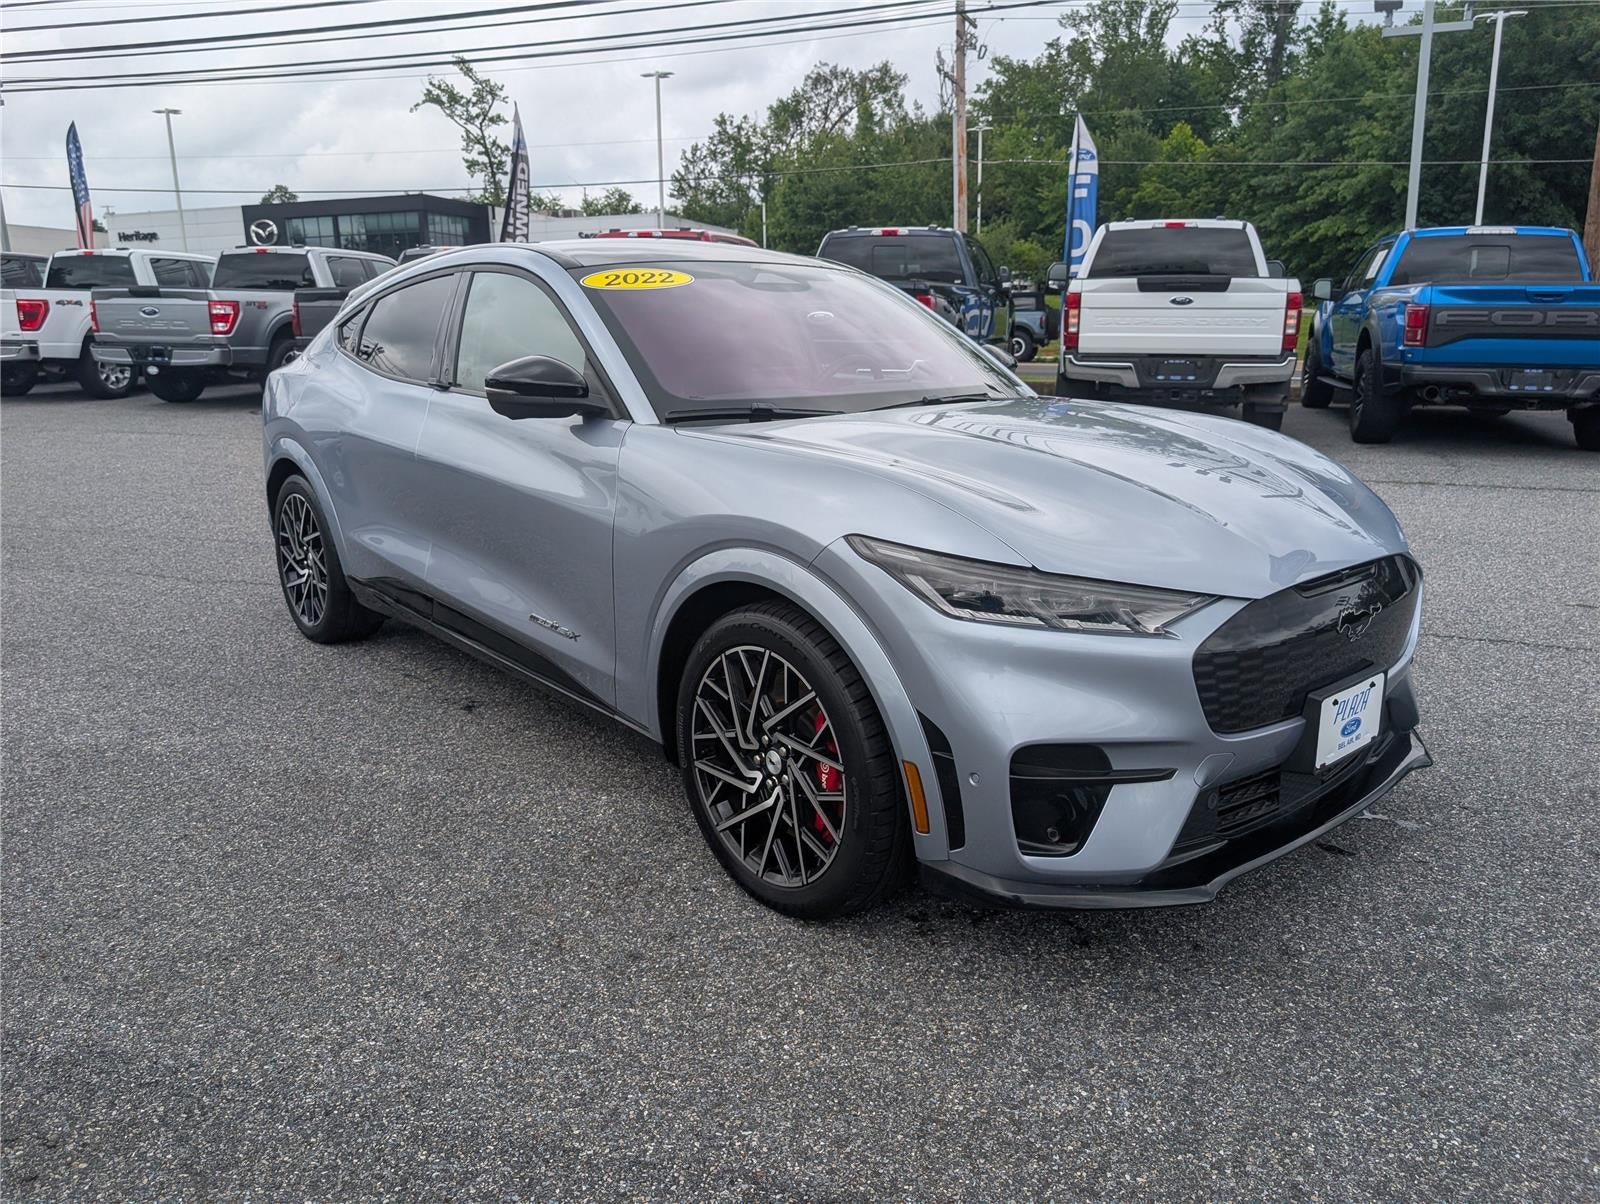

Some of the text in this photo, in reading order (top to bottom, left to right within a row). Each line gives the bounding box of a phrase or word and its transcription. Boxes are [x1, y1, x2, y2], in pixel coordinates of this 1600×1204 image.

[117, 230, 158, 243] Heritage
[604, 271, 675, 287] 2022
[1333, 687, 1372, 725] PLAZA
